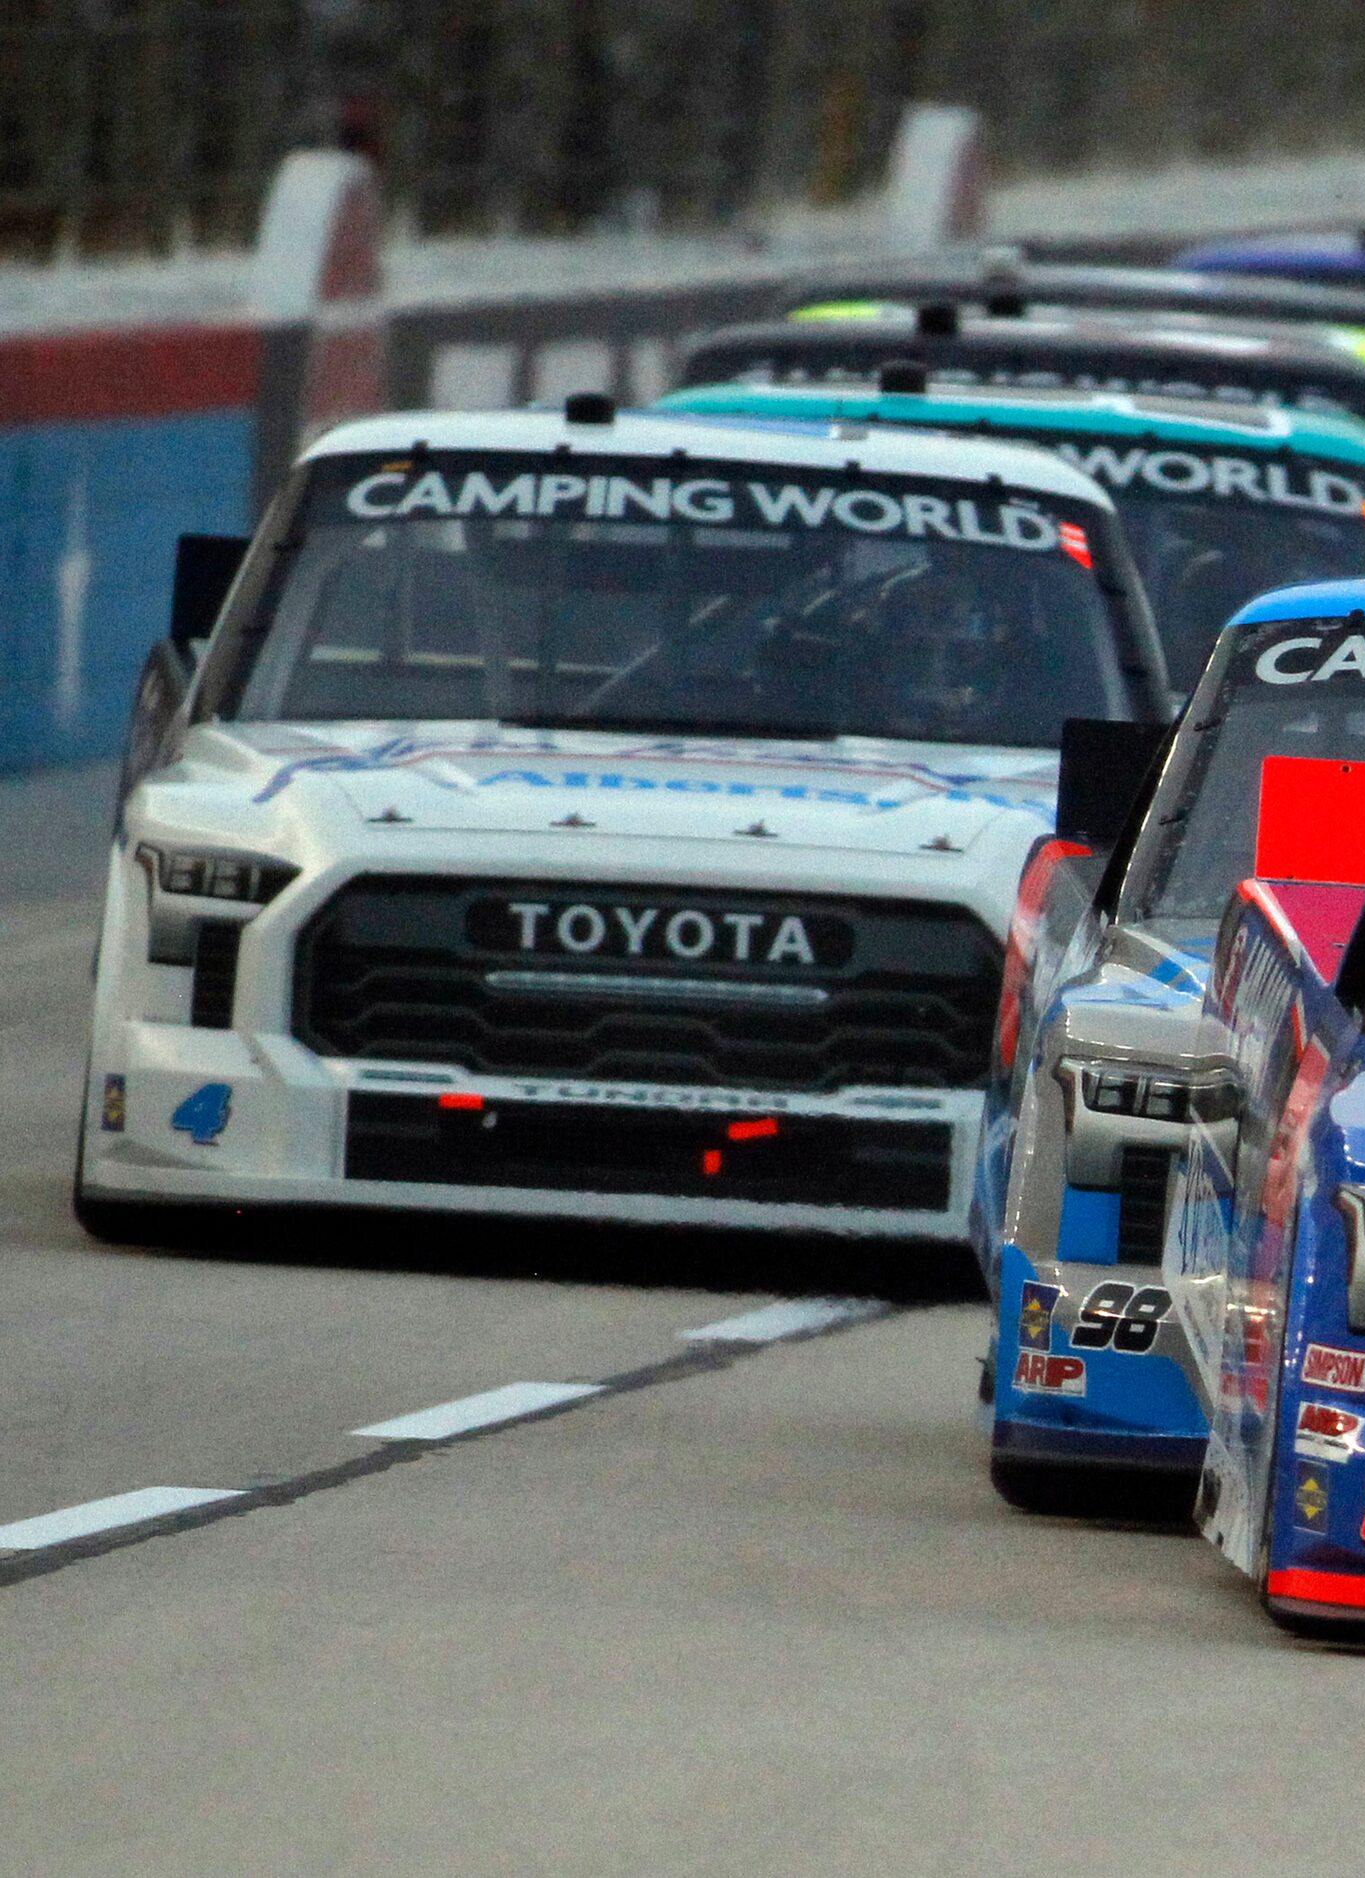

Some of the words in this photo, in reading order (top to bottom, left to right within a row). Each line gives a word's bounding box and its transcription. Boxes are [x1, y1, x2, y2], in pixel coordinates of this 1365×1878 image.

[347, 471, 735, 523] CAMPING
[750, 483, 1060, 553] WORLD
[1060, 443, 1365, 517] WORLD
[508, 901, 815, 965] TOYOTA
[170, 1082, 233, 1147] 4
[1069, 1279, 1173, 1356] 98
[1015, 1352, 1085, 1388] ARP
